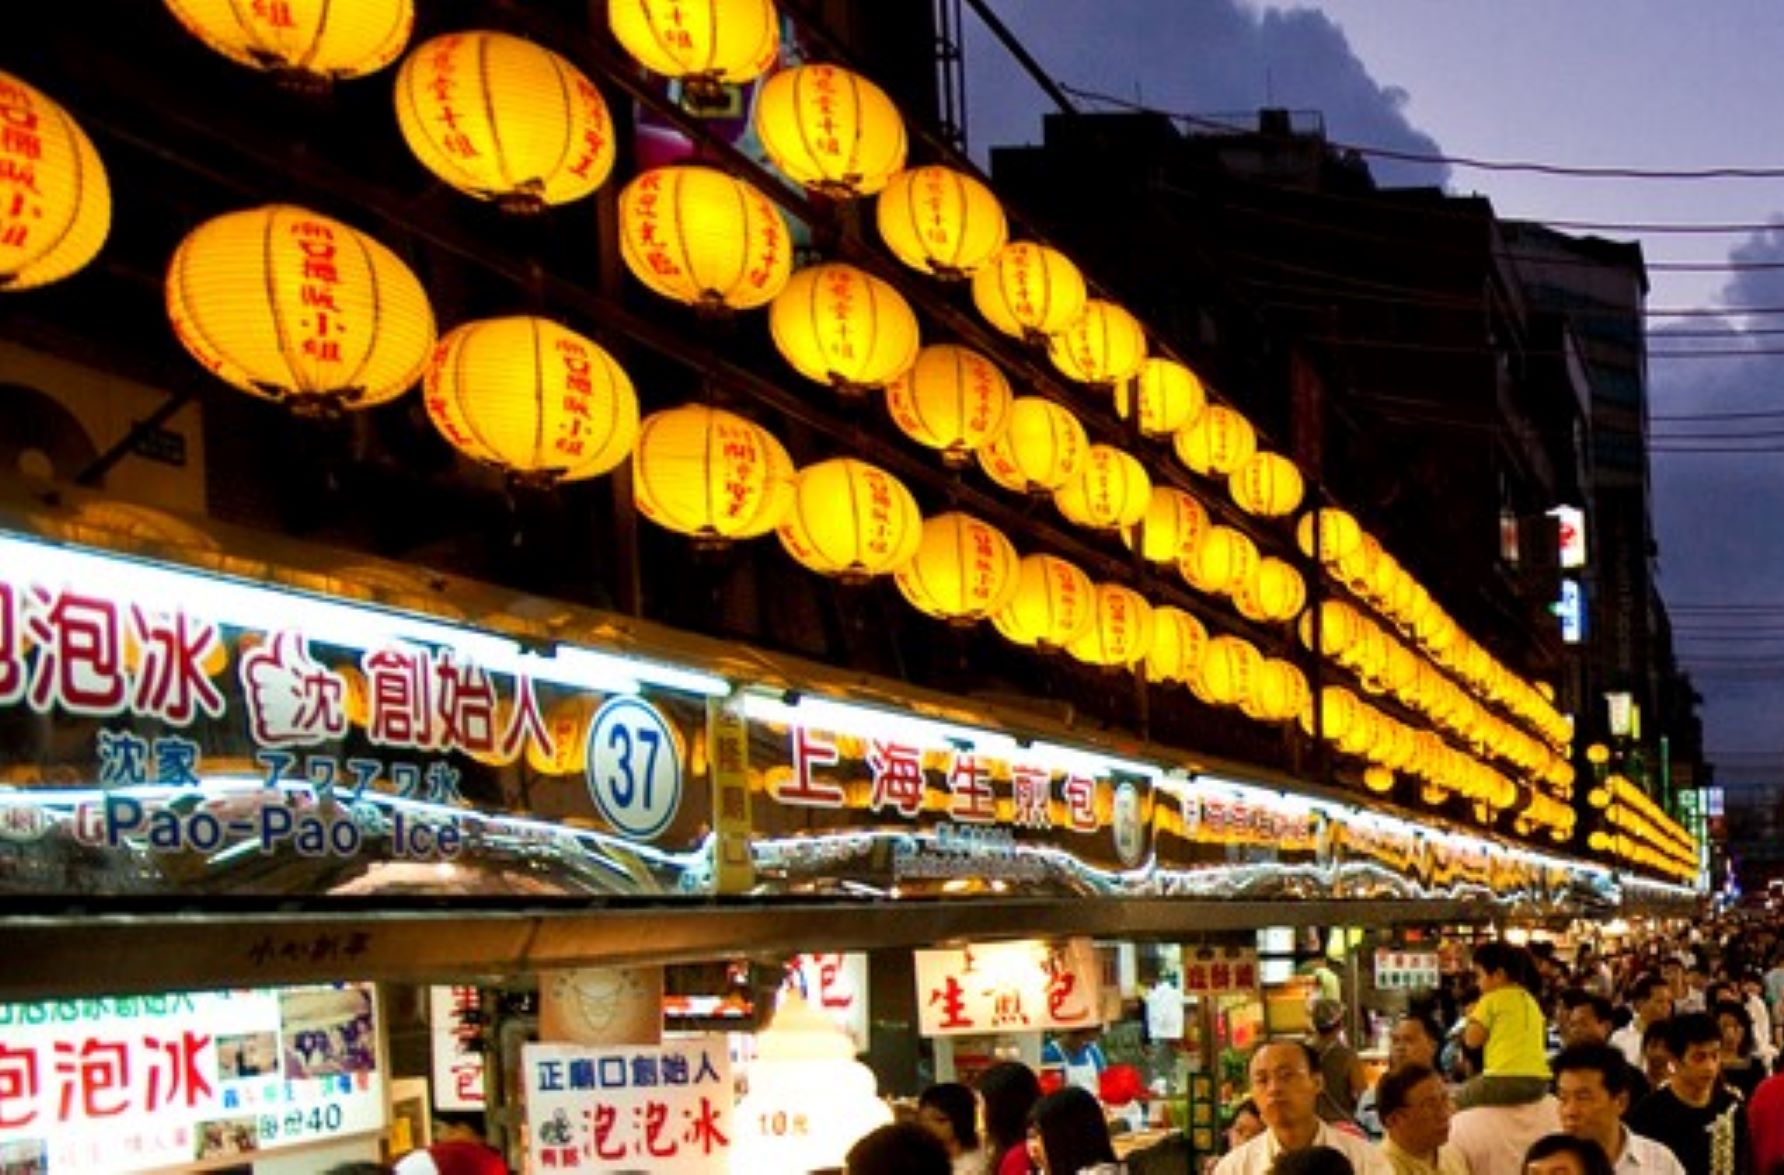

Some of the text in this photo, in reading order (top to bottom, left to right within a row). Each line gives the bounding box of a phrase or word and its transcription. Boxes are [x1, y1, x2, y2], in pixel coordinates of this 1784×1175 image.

[0, 579, 222, 722] 泡冰
[368, 651, 555, 758] 創始人
[100, 734, 199, 786] 沈家
[607, 722, 662, 812] 37
[778, 726, 1097, 832] 上海生煎包
[104, 796, 461, 855] Pao-Pao Ice
[582, 1097, 729, 1160] 泡泡冰
